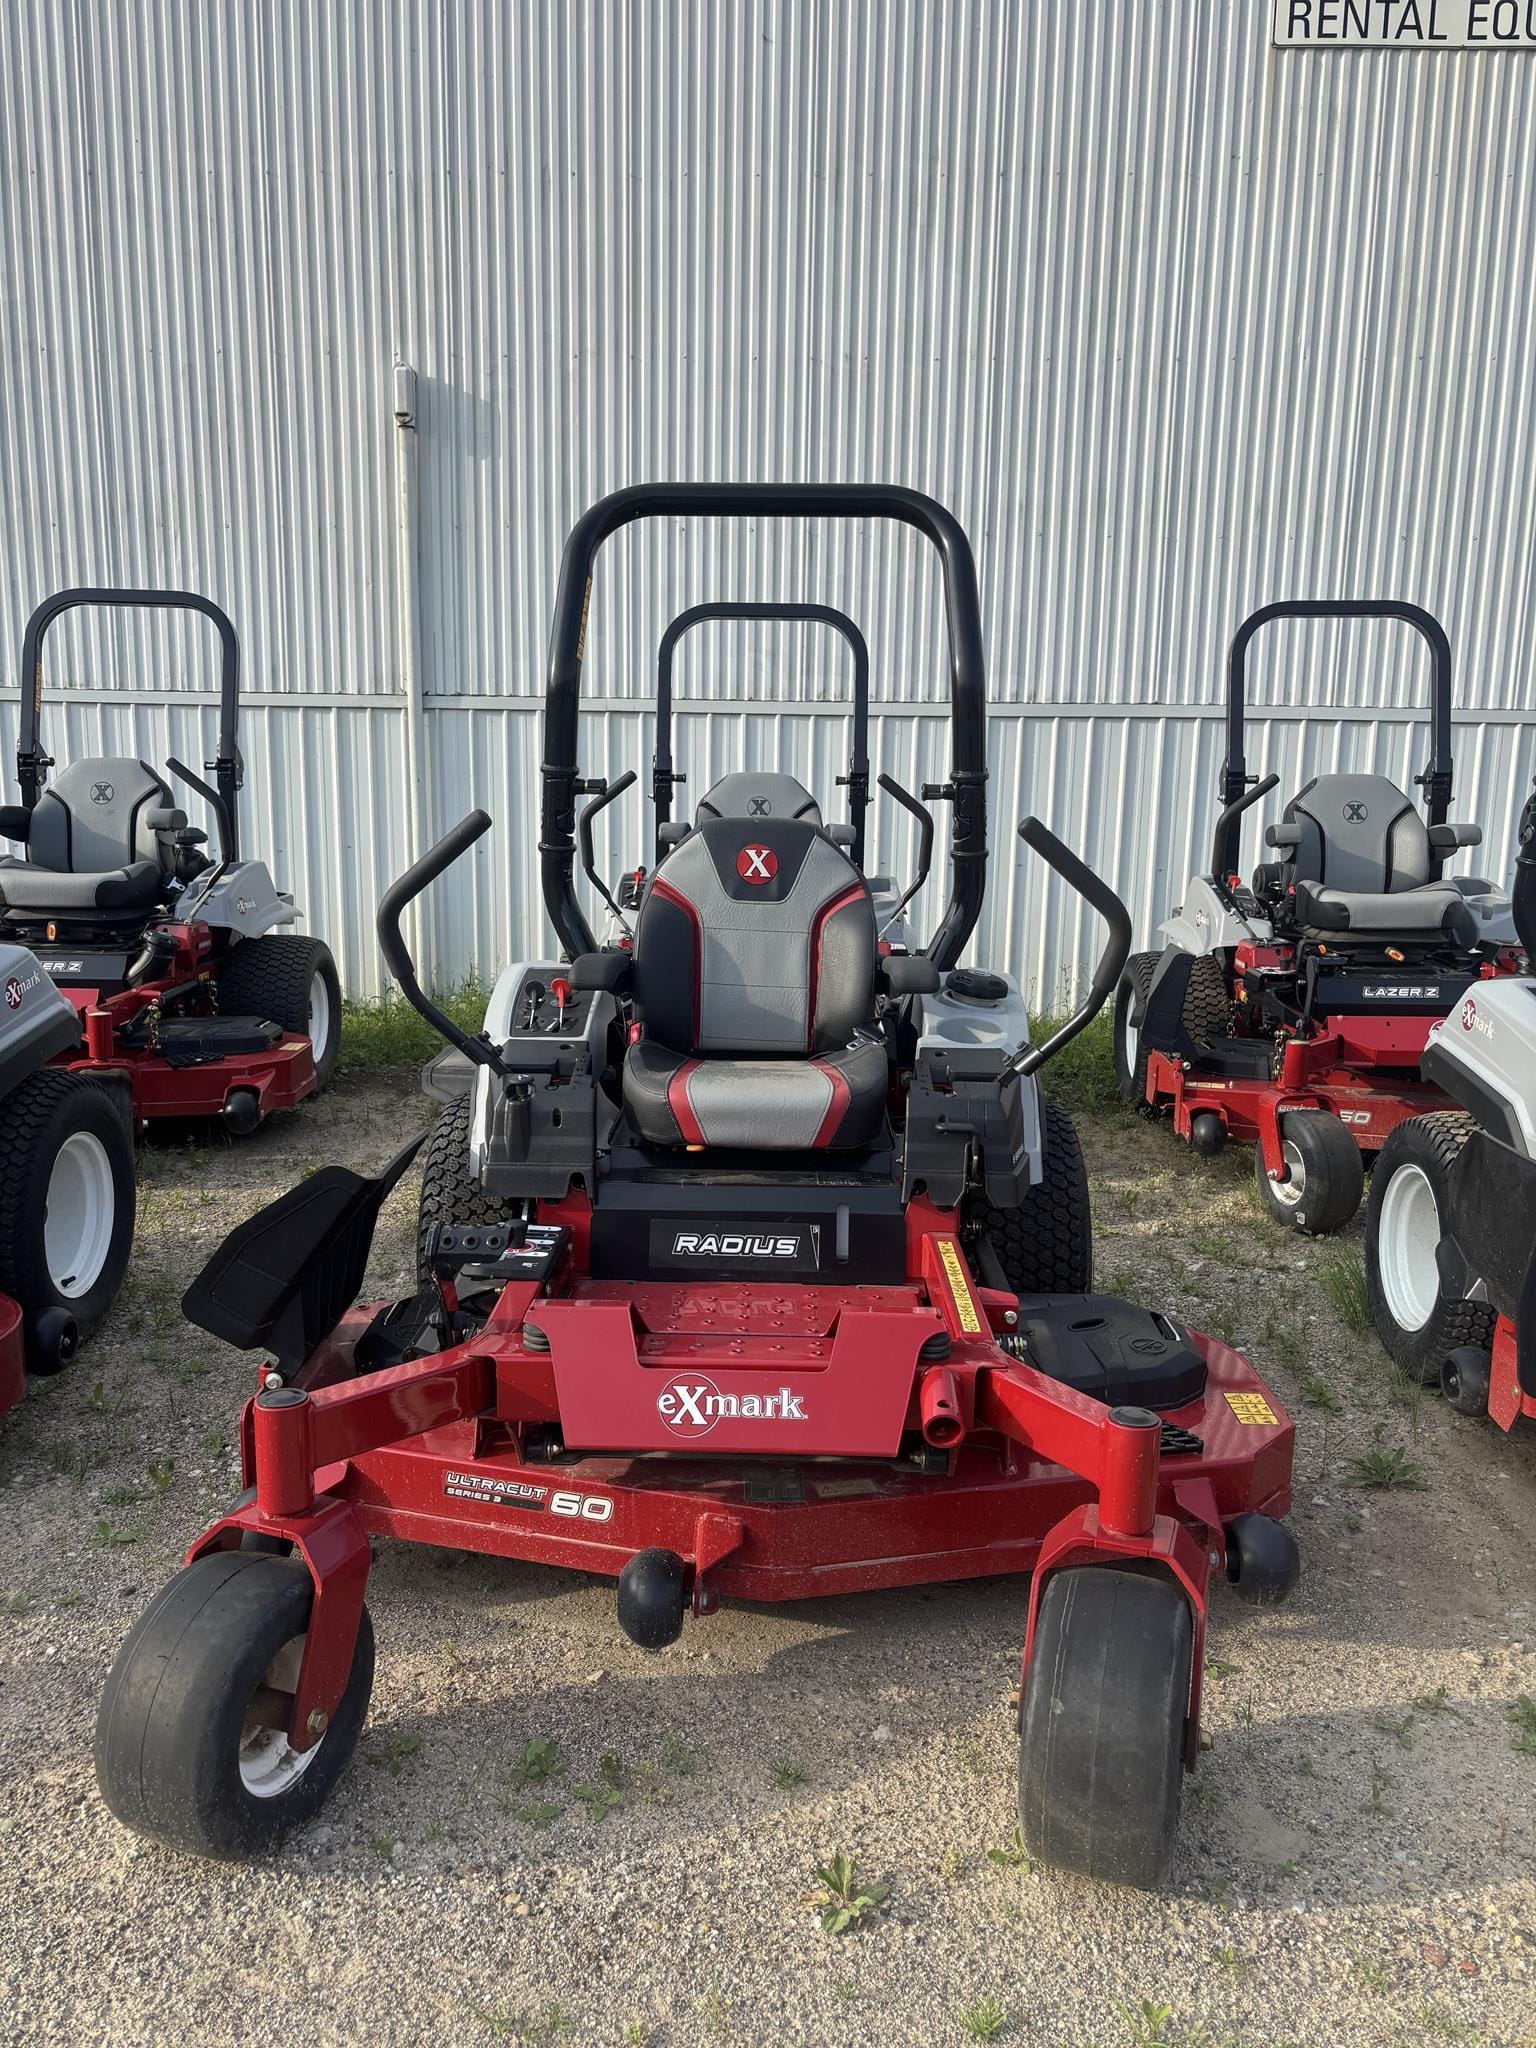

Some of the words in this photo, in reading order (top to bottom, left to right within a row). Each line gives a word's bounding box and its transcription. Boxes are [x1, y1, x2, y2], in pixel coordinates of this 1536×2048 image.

[1287, 0, 1448, 40] RENTAL
[93, 783, 112, 802] X
[749, 798, 769, 816] X
[1345, 803, 1365, 821] X
[743, 848, 773, 879] X
[5, 971, 41, 1006] eXmark
[1363, 986, 1422, 998] LAZER
[1425, 987, 1439, 998] Z
[1462, 1002, 1495, 1040] eXmark
[673, 1234, 799, 1257] RADIUS
[658, 1385, 806, 1425] eXmark
[446, 1472, 547, 1498] ULTRACUT
[446, 1487, 490, 1501] SERIES
[550, 1491, 613, 1522] 60
